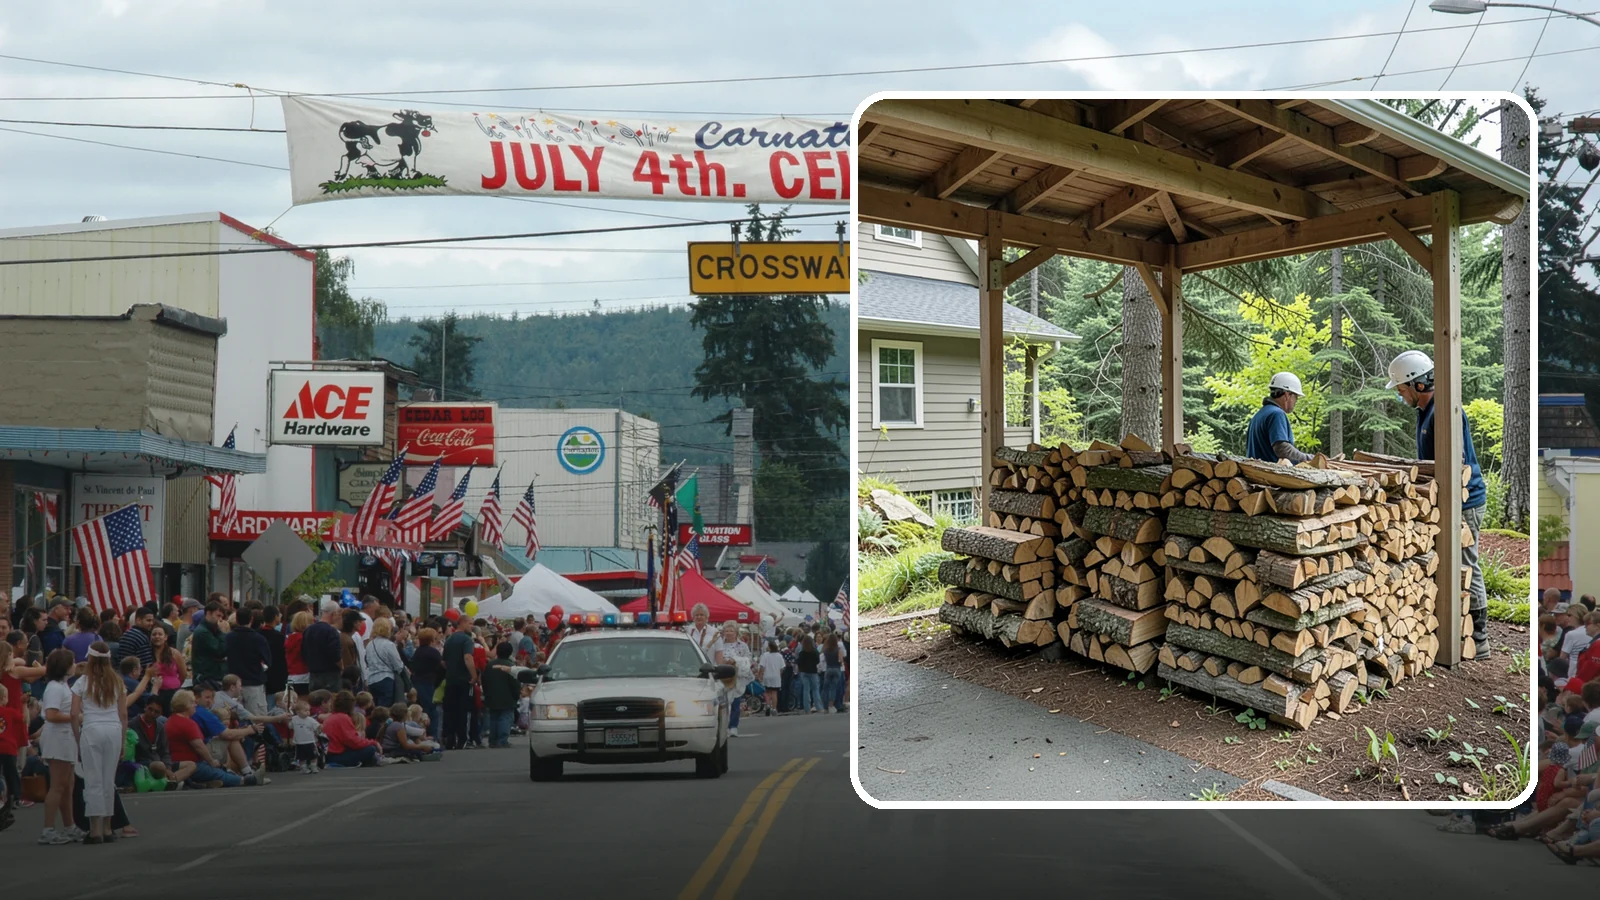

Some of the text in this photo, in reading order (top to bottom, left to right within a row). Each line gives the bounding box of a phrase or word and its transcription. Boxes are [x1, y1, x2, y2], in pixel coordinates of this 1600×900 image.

[481, 141, 605, 192] JULY
[632, 150, 747, 198] 4th.
[697, 255, 850, 280] CROSSWA
[283, 380, 373, 419] ACE
[405, 409, 453, 422] CEDAR
[284, 421, 371, 436] Hardware
[83, 485, 155, 495] St. Vincent de Paul
[699, 535, 730, 543] GLASS
